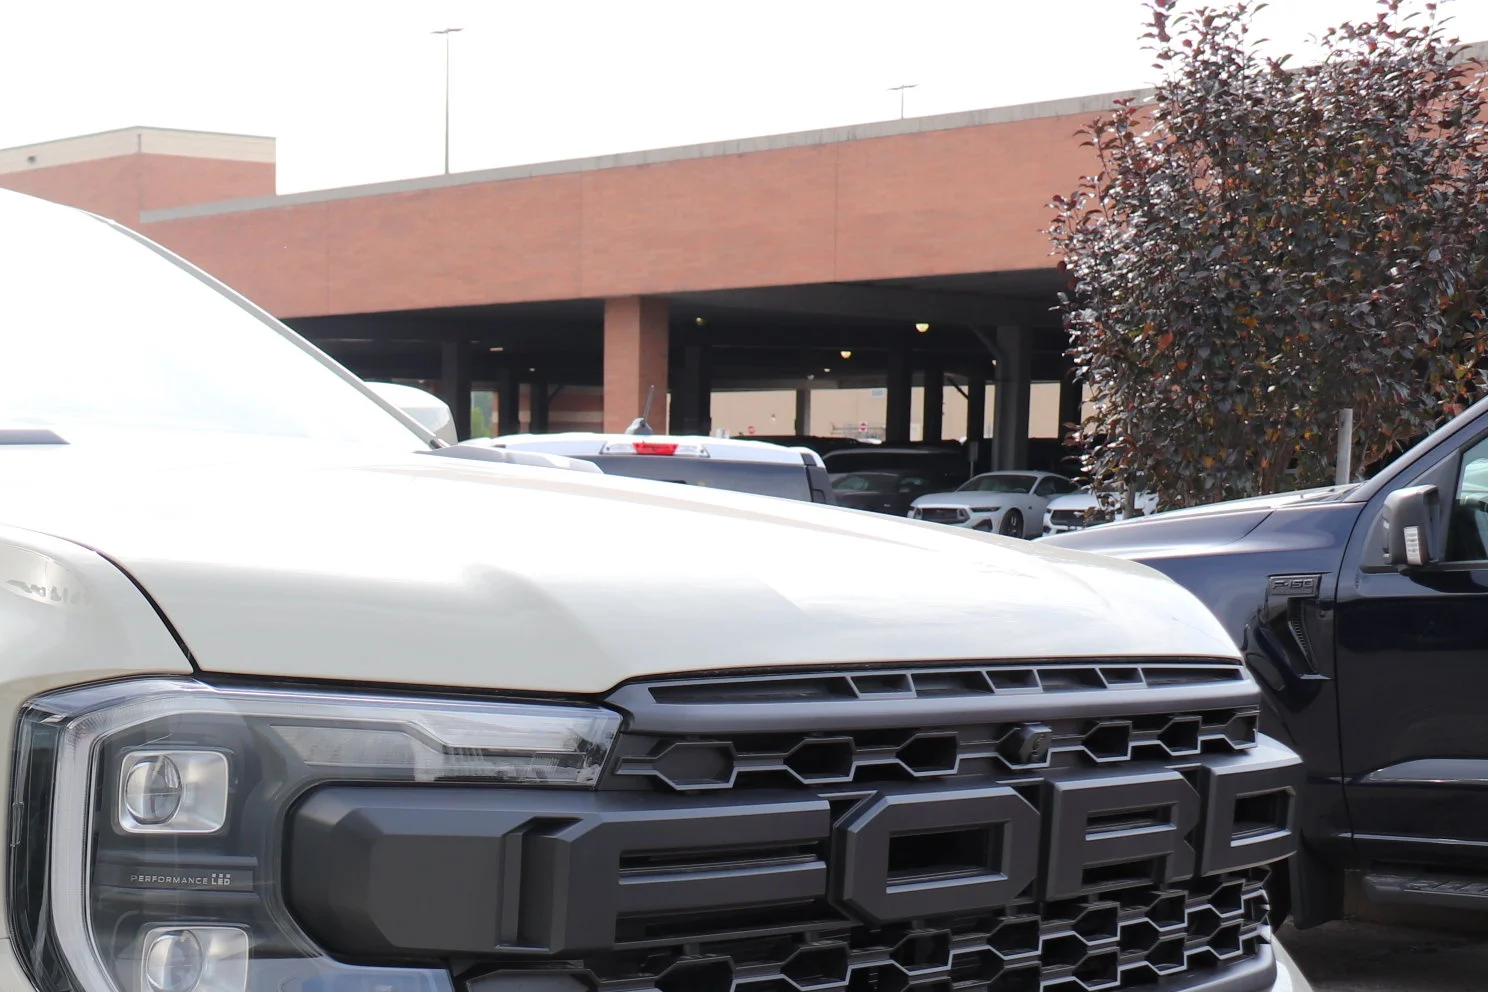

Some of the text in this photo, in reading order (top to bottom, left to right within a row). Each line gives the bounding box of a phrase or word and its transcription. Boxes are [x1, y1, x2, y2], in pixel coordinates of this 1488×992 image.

[131, 874, 231, 886] PERFORMANCE LED
[547, 757, 1302, 953] FORD
